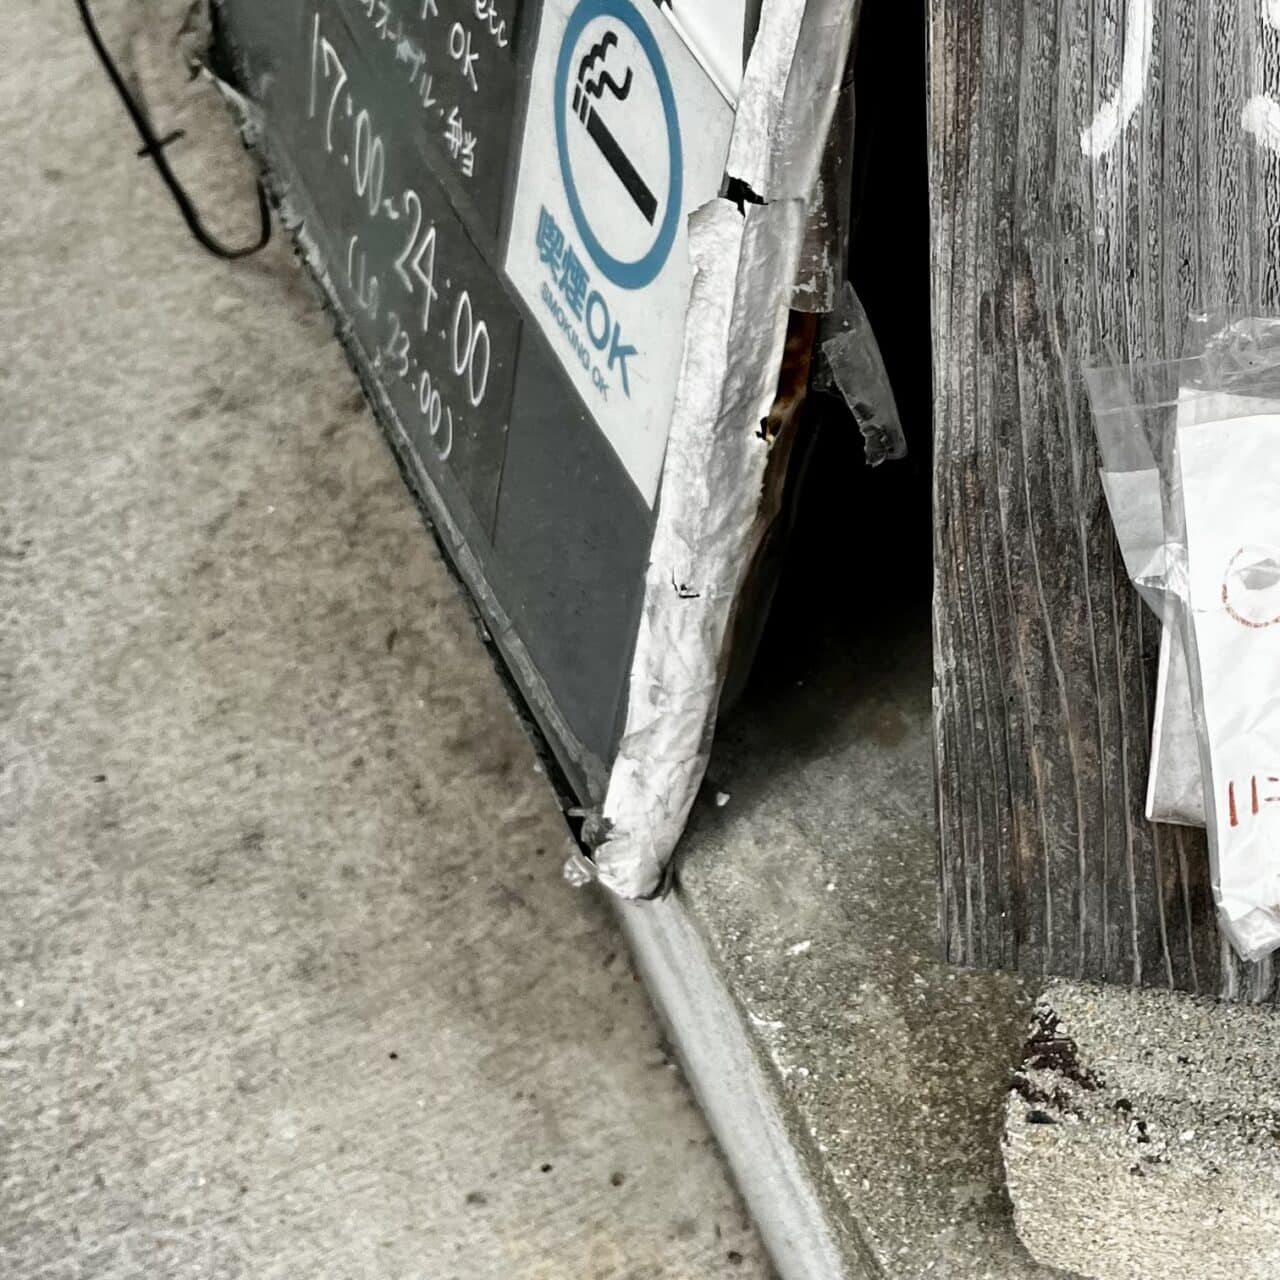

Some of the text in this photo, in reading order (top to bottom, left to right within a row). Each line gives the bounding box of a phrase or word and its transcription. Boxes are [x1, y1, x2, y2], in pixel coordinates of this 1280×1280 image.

[450, 22, 479, 92] OK
[536, 203, 639, 399] 喫煙OK
[541, 281, 610, 403] SMOKING OK
